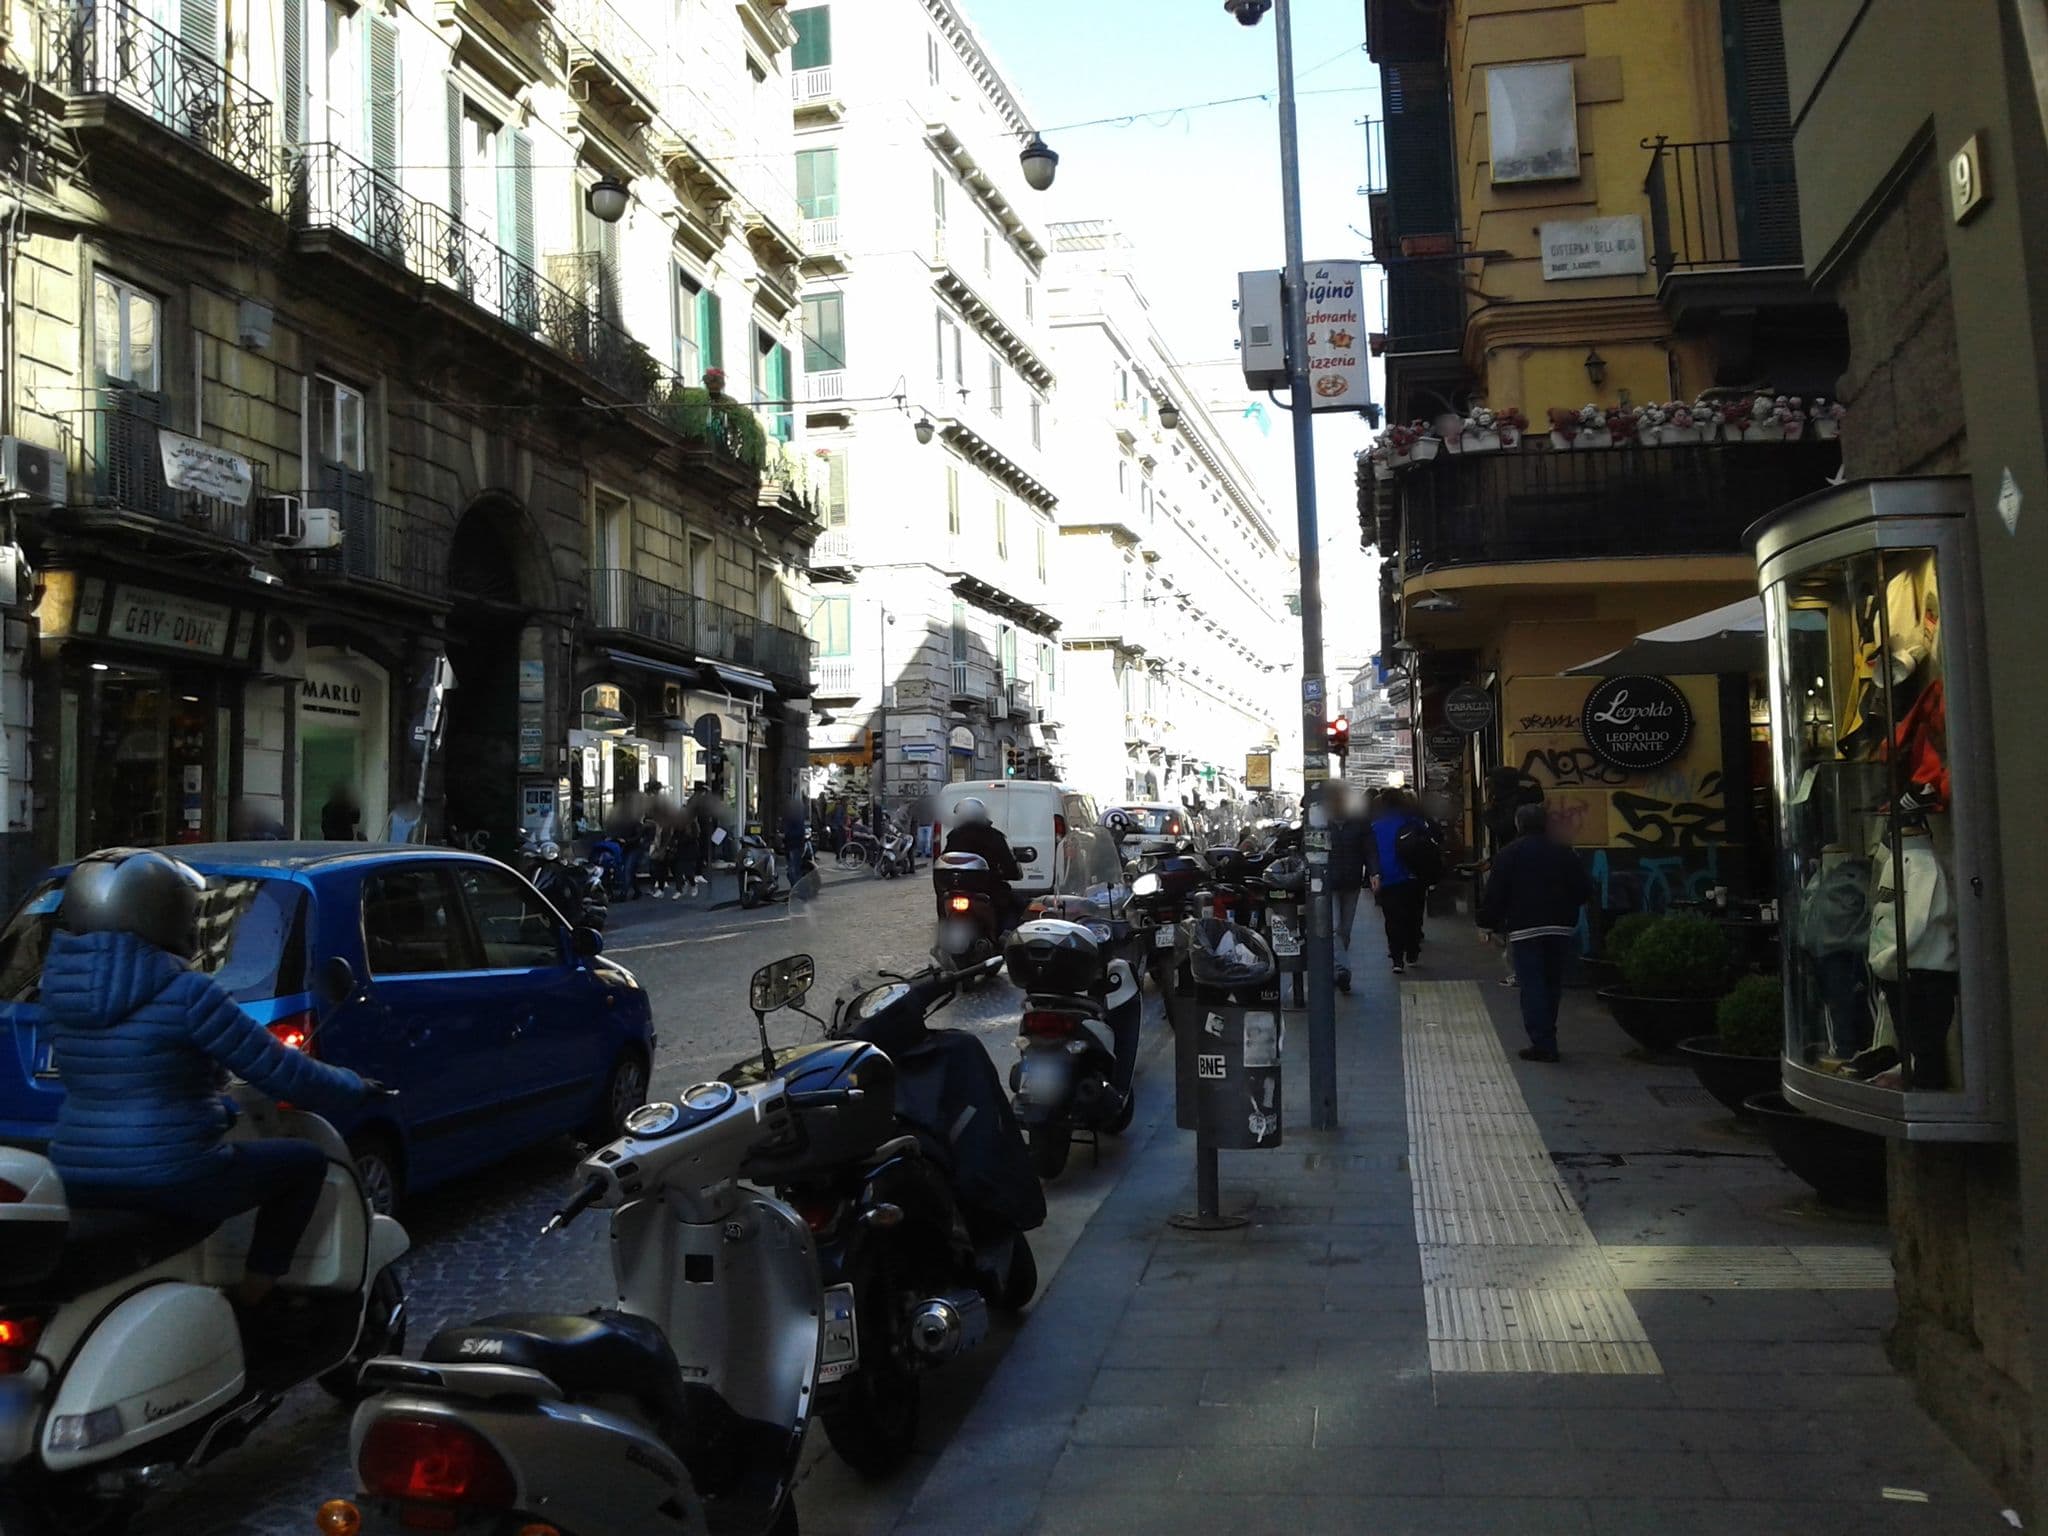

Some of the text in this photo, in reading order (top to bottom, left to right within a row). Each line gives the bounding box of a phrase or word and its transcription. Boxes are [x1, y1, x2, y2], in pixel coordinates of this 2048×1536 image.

[1956, 152, 1971, 205] 9
[1315, 268, 1329, 279] da
[1306, 310, 1357, 324] istorante
[1593, 689, 1673, 725] Leopoldo
[1605, 731, 1670, 743] LEOPOLDO
[1611, 741, 1665, 752] INFANTE
[1199, 1056, 1227, 1076] BNE
[459, 1338, 504, 1354] SYM
